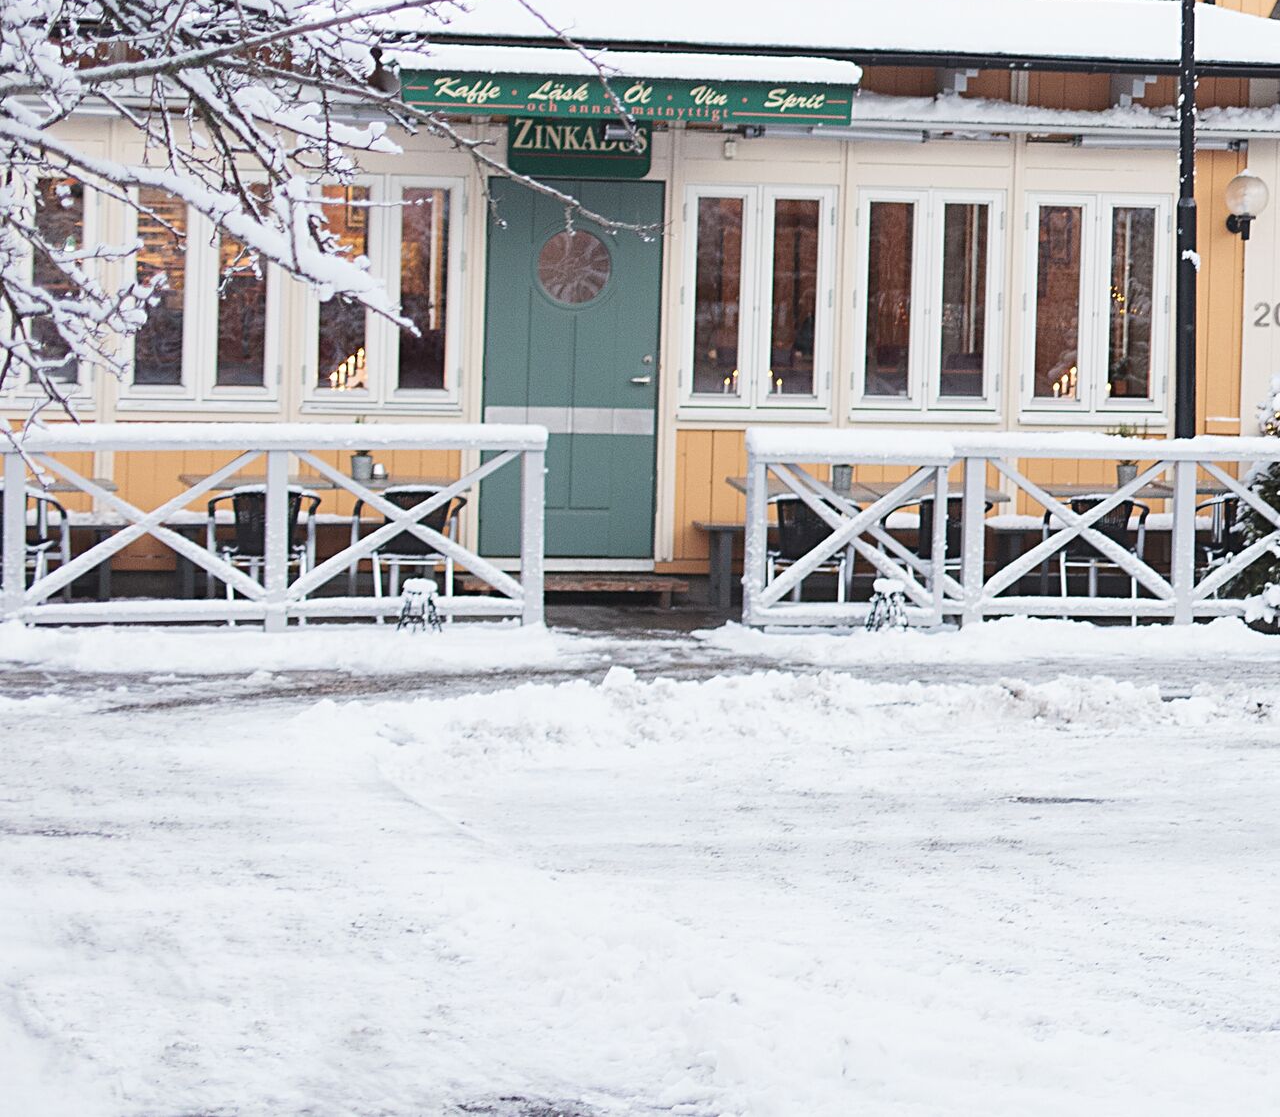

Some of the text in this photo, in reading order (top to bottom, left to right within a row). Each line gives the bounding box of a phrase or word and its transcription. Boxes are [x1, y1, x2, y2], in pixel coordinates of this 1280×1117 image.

[434, 78, 826, 112] Kaffe Läsk Öl Vin Sprit
[527, 100, 558, 113] och
[631, 105, 729, 121] matnyttigt
